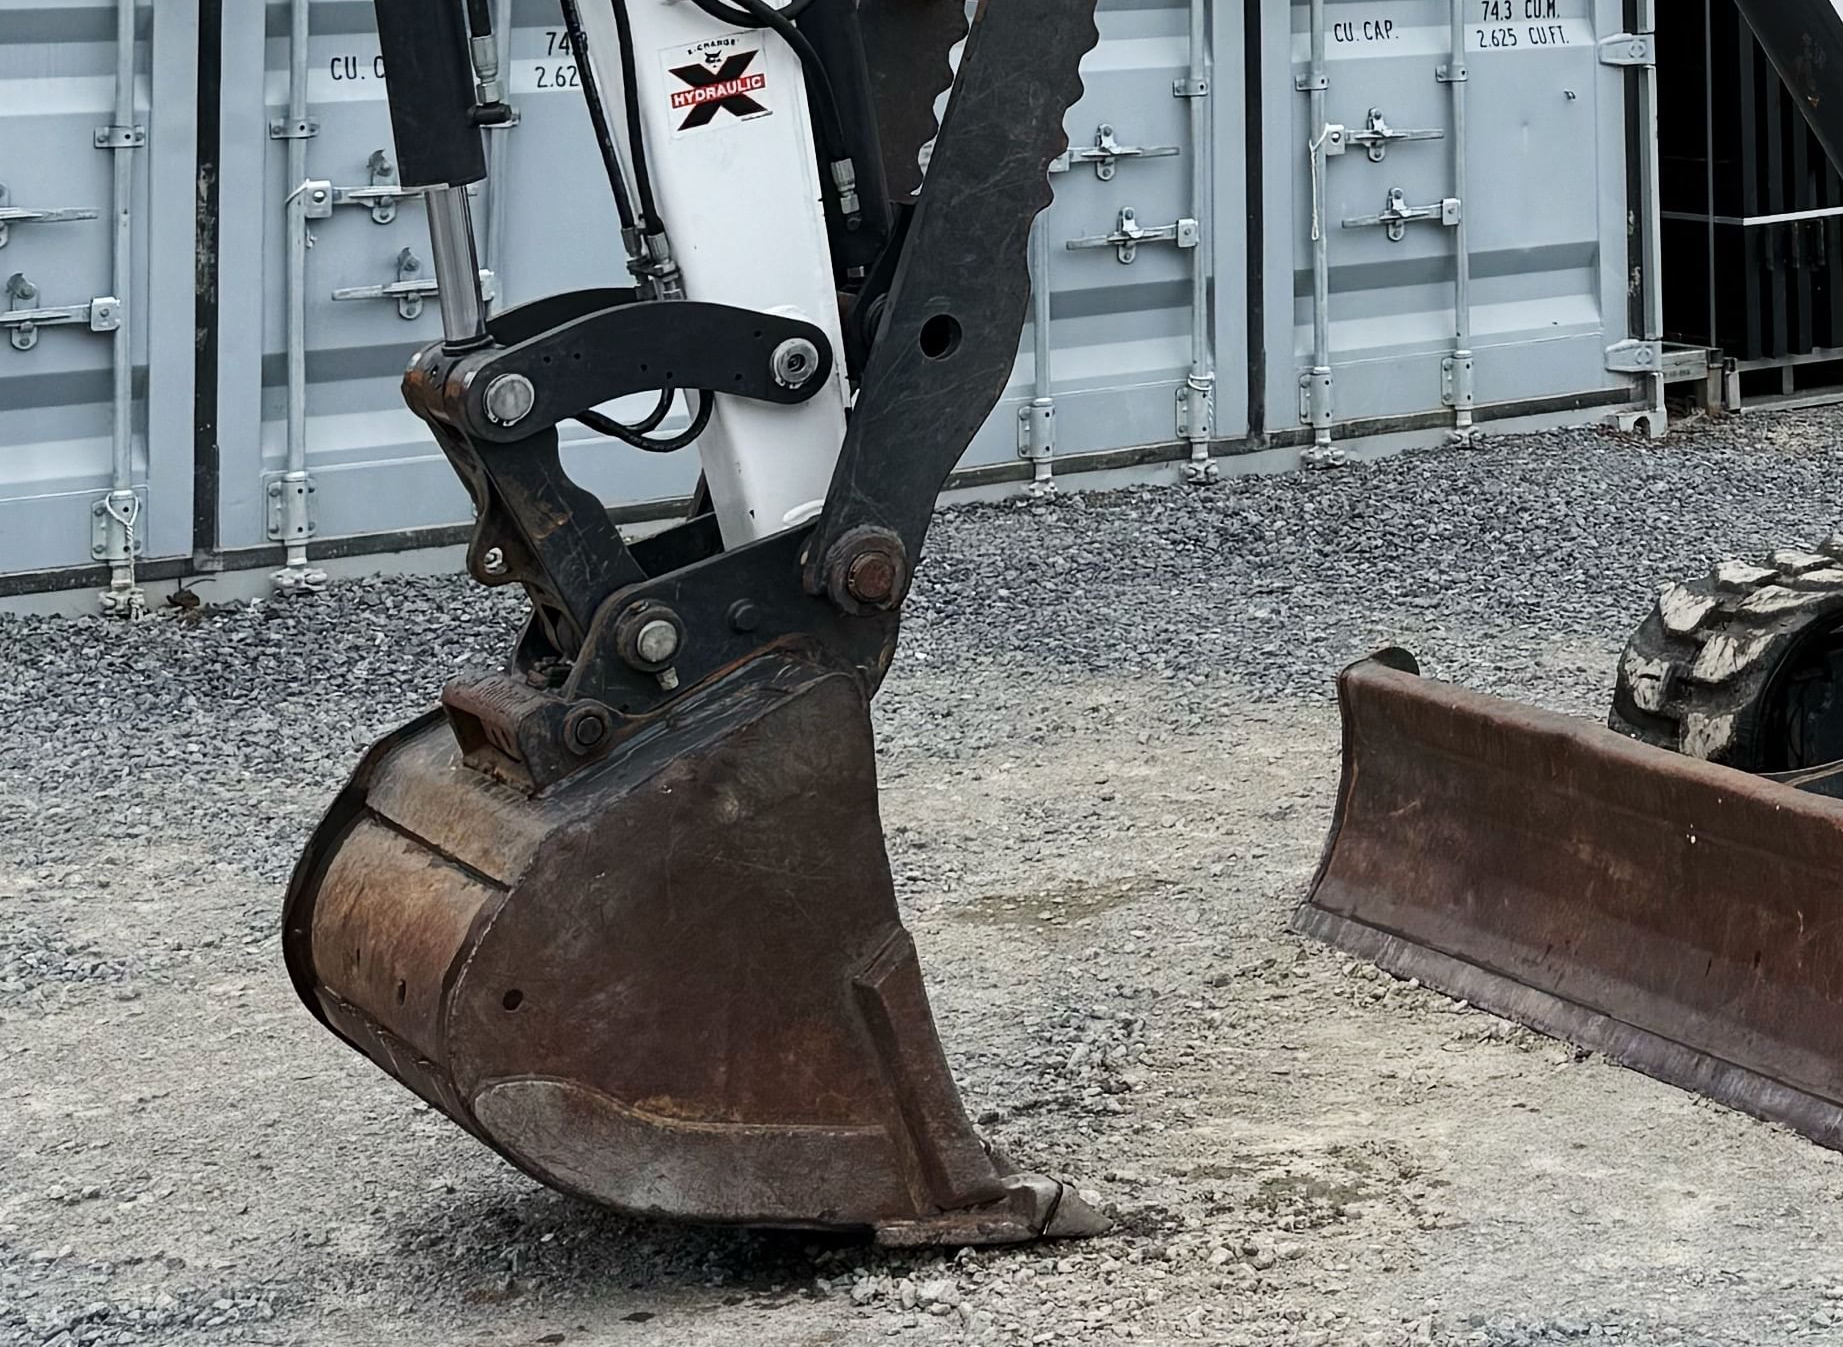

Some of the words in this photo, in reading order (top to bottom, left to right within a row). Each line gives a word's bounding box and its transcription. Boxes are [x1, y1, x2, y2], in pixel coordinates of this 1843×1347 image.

[1481, 0, 1512, 21] 74.3
[1476, 30, 1517, 48] 2.625
[534, 65, 579, 88] 2.62
[672, 75, 763, 107] HYDRAULIC
